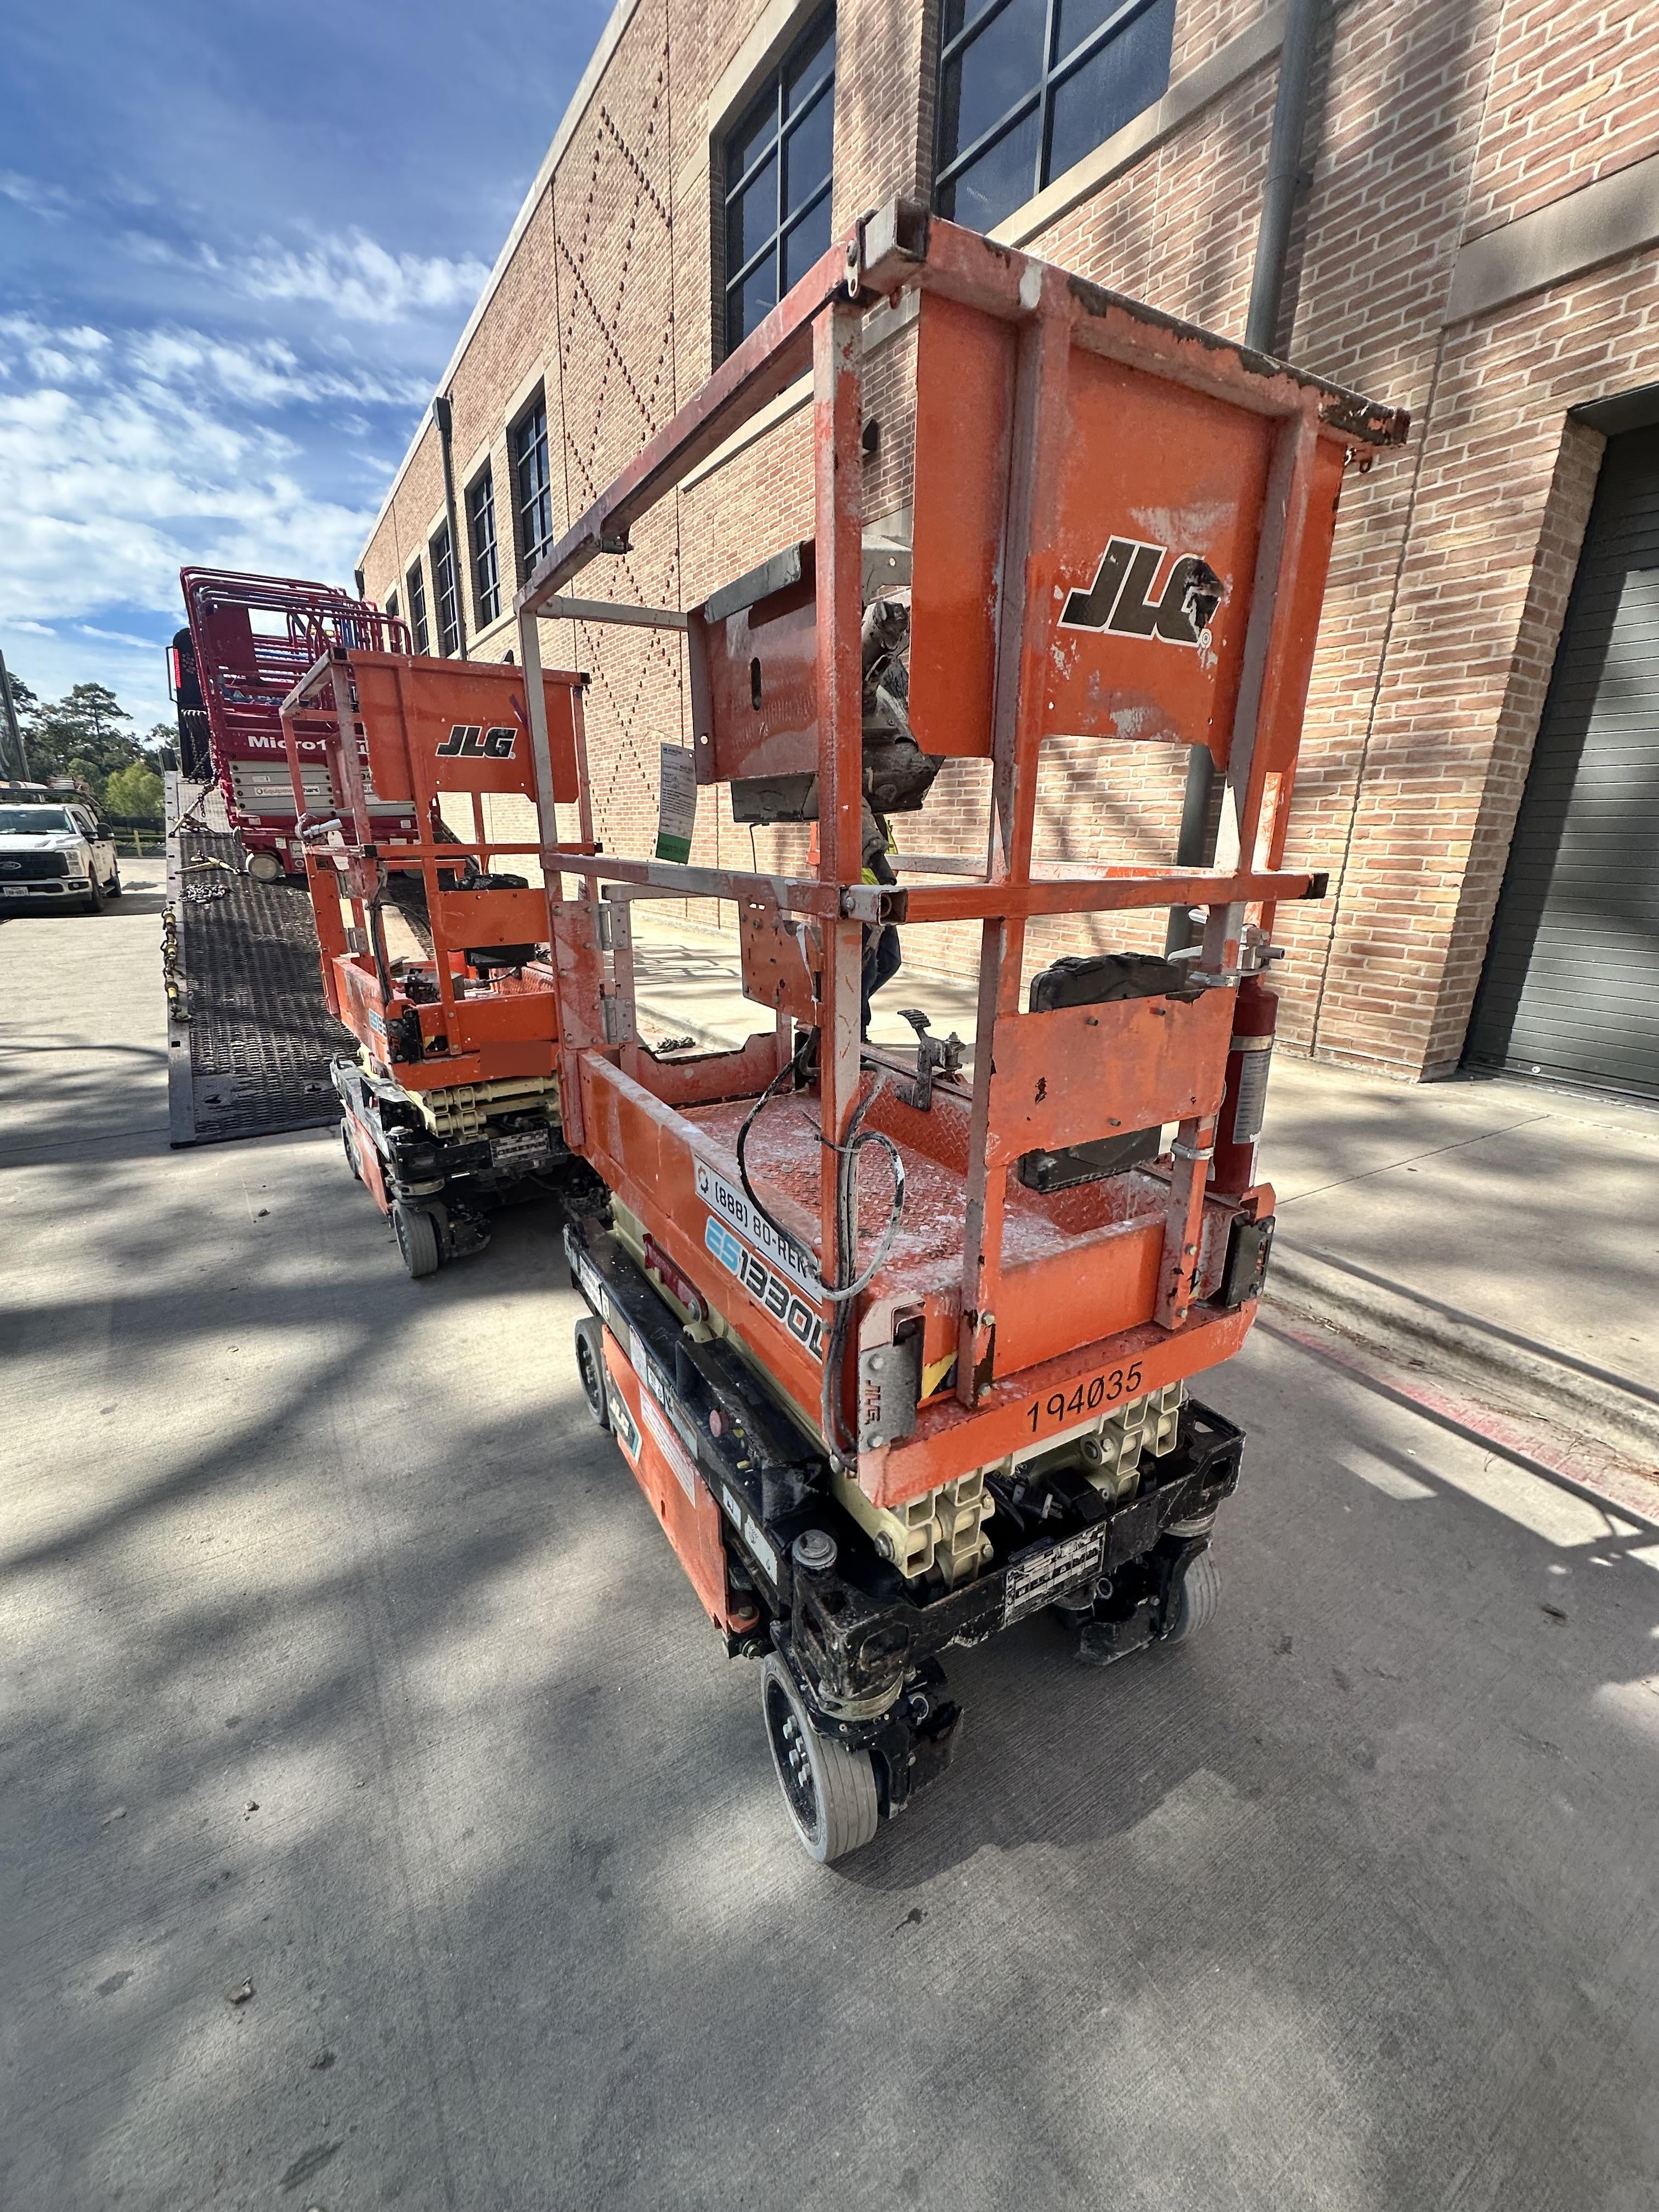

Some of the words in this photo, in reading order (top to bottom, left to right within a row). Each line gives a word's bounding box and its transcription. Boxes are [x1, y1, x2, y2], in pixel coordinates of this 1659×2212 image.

[1058, 535, 1220, 646] JLG
[248, 736, 326, 751] Micro1
[436, 725, 518, 758] JLG
[263, 785, 319, 794] Equipmehare
[715, 1181, 748, 1228] (888)
[753, 1215, 808, 1278] 80-REN
[1027, 1361, 1143, 1432] 194035
